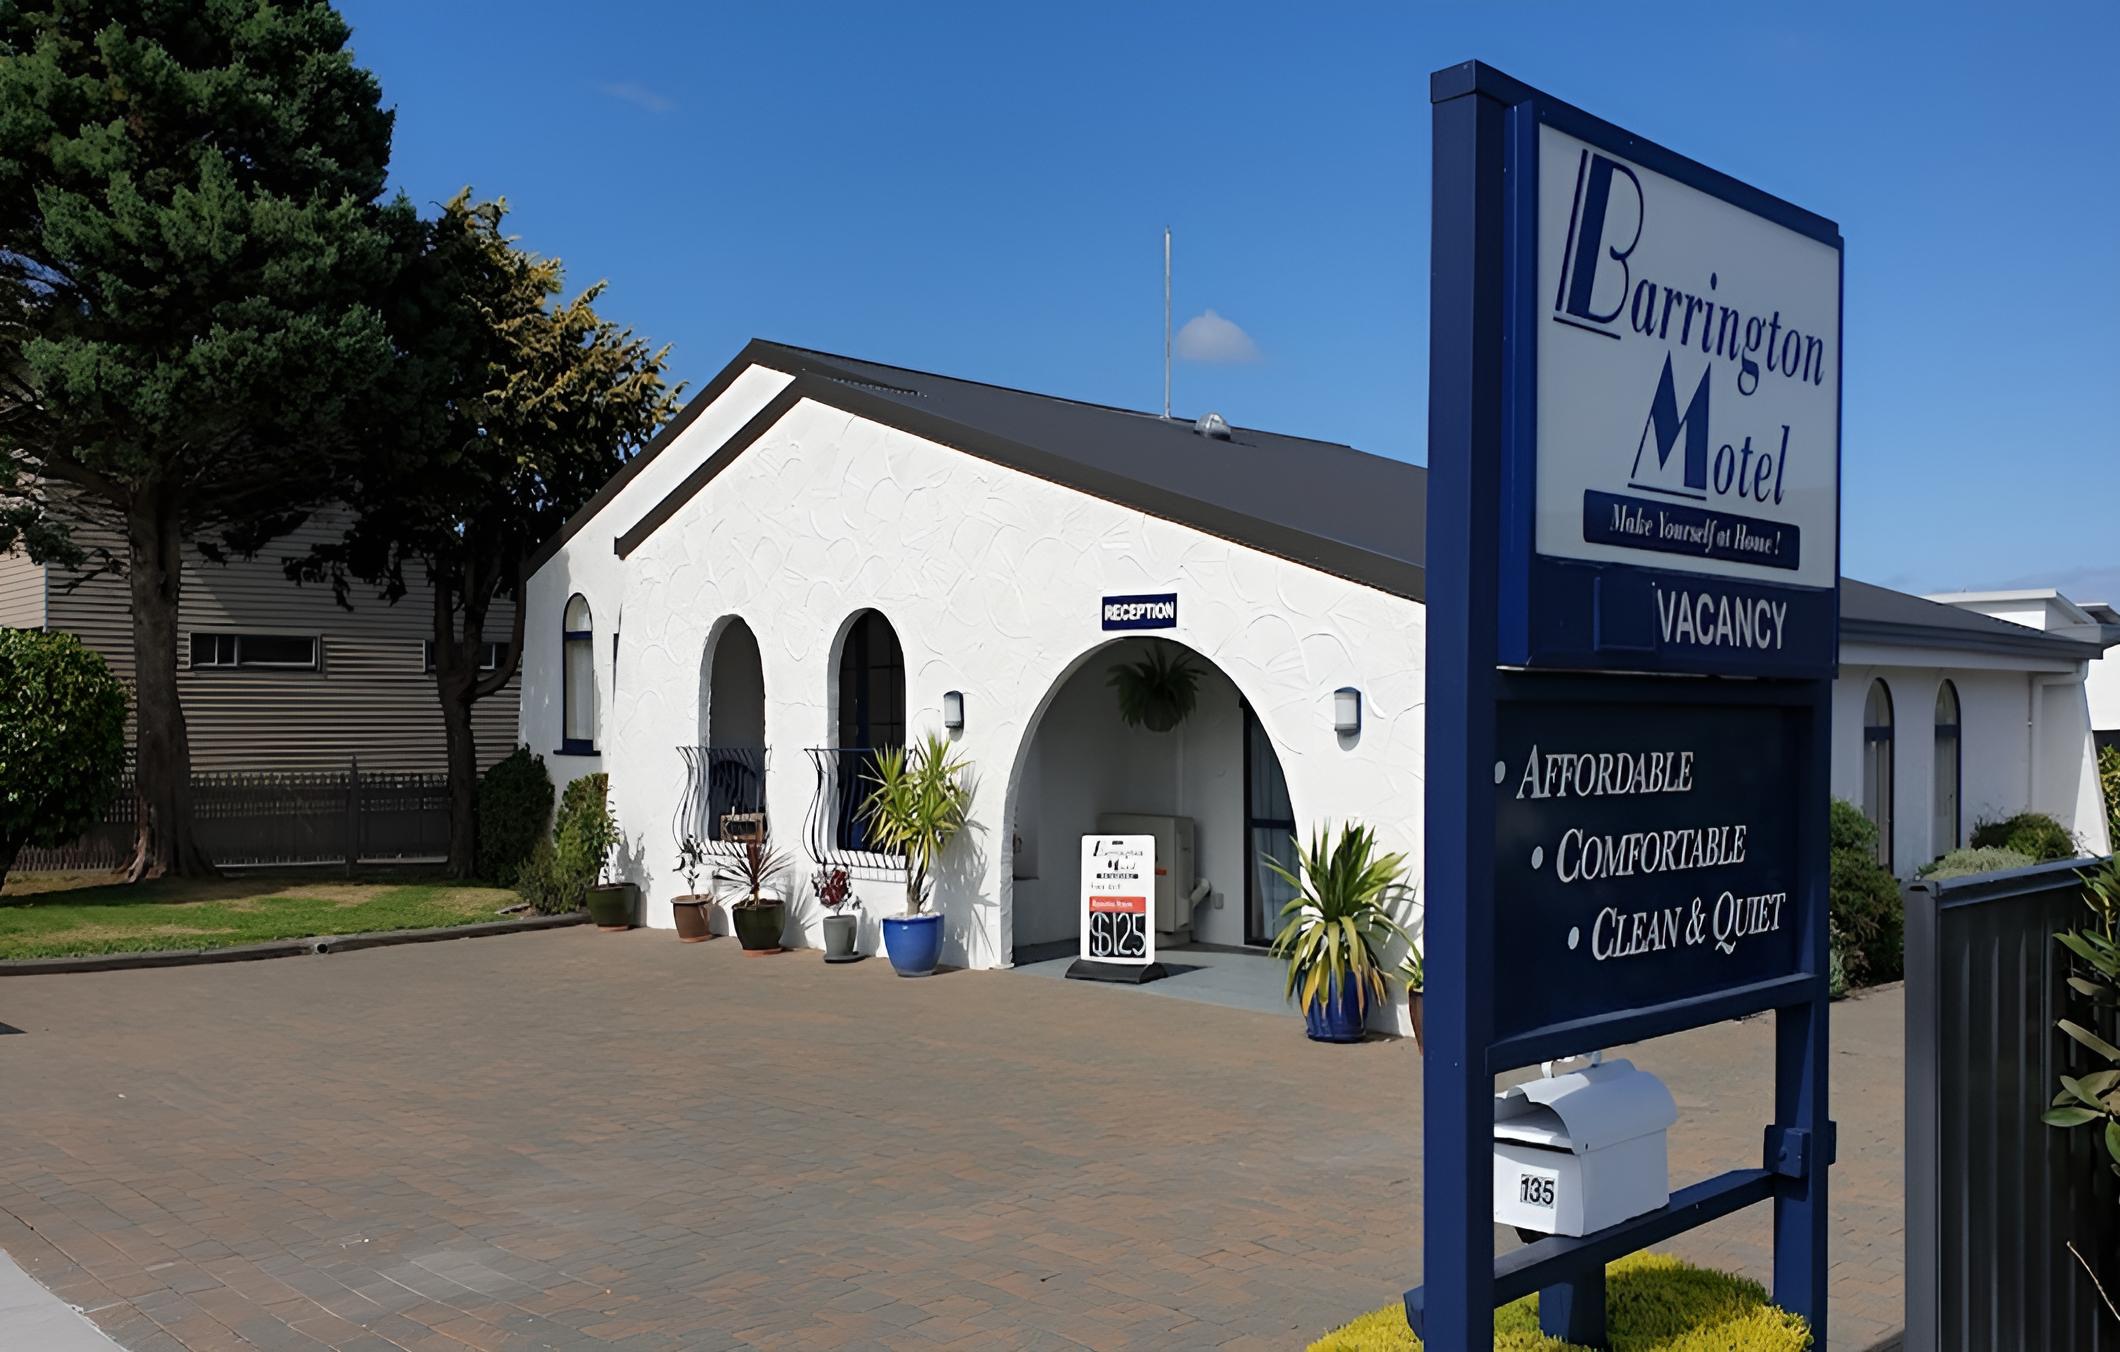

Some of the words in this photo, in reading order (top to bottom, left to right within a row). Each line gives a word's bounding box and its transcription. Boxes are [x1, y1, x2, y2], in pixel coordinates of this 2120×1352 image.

[1554, 149, 1825, 396] Barrington
[1629, 350, 1791, 505] Motel
[1609, 503, 1653, 537] Make
[1658, 511, 1718, 554] Yourself
[1716, 528, 1730, 548] at
[1104, 601, 1175, 621] RECEPTION
[1656, 588, 1787, 650] VACANCY
[1515, 744, 1694, 800] AFFORDABLE
[1556, 825, 1747, 883] COMFORTABLE
[1089, 911, 1146, 957] $125
[1591, 906, 1684, 961] CLEAN
[1685, 897, 1706, 945] &
[1712, 891, 1787, 955] QUIET
[1520, 1177, 1555, 1205] 135
